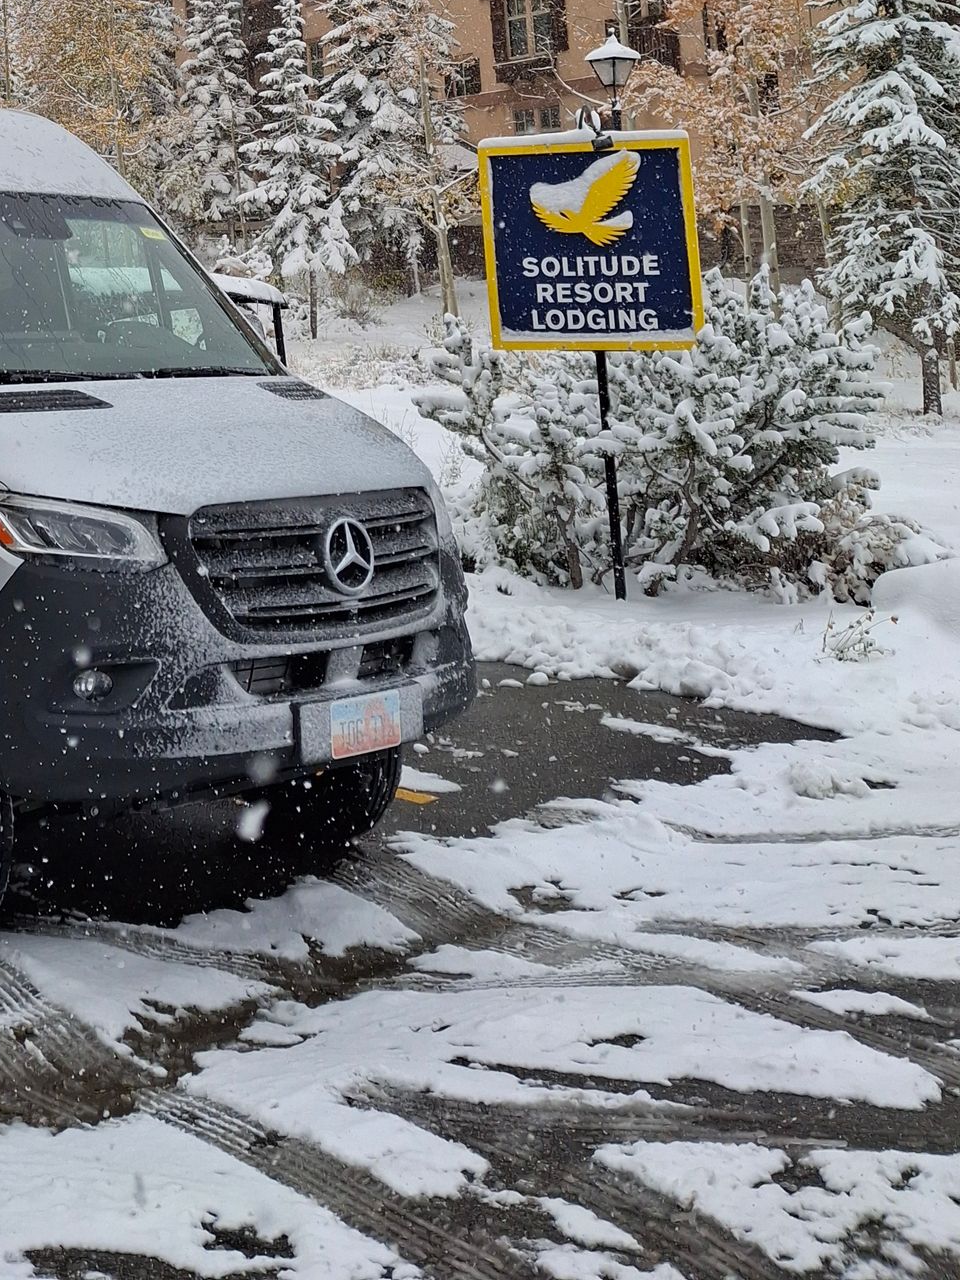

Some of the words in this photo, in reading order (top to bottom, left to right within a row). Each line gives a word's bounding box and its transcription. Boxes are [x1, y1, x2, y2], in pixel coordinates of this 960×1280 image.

[522, 255, 661, 277] SOLITUDE
[536, 282, 649, 304] RESORT
[531, 308, 659, 331] LODGING
